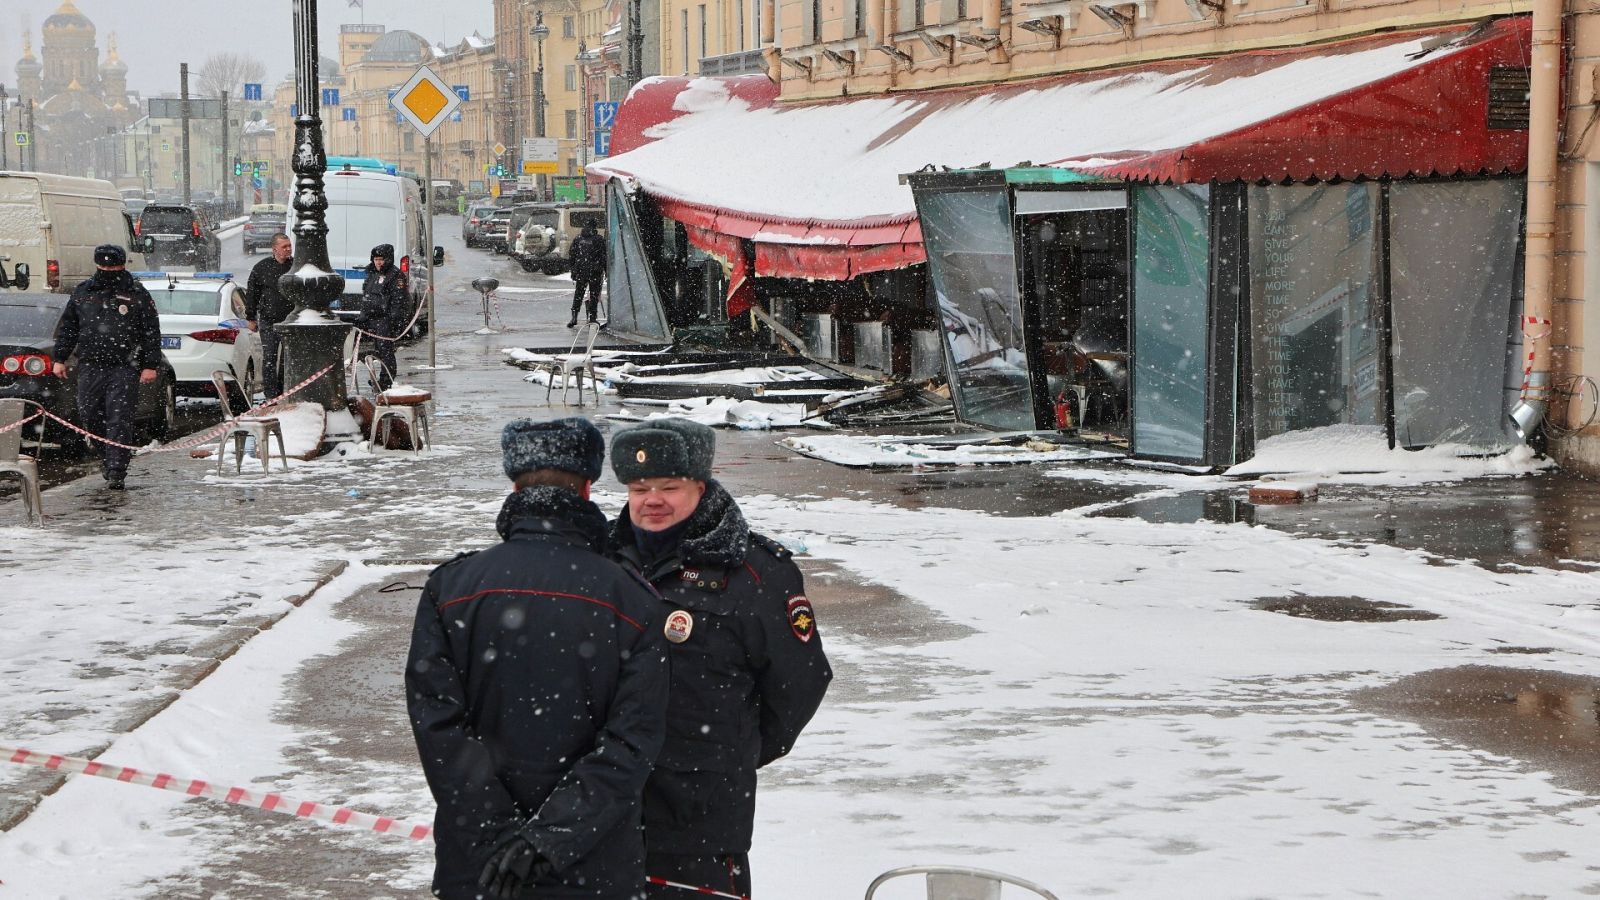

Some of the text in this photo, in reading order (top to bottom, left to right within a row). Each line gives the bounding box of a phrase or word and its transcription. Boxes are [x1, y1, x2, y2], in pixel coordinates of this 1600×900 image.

[1264, 210, 1286, 220] YOU
[1264, 224, 1296, 234] CAN'T
[1265, 239, 1288, 248] GIVE
[1265, 253, 1295, 262] YOUR
[1265, 267, 1288, 276] LIFE
[1265, 281, 1296, 290] MORE
[1265, 295, 1289, 304] TIME
[1267, 309, 1280, 318] SO
[1267, 323, 1290, 332] GIVE
[1268, 336, 1290, 346] THE
[1269, 351, 1292, 360] TIME
[1268, 365, 1289, 374] YOU
[1268, 379, 1294, 388] HAVE
[1269, 393, 1292, 402] LEFT
[1269, 407, 1297, 416] MORE
[1269, 421, 1290, 430] LIFE
